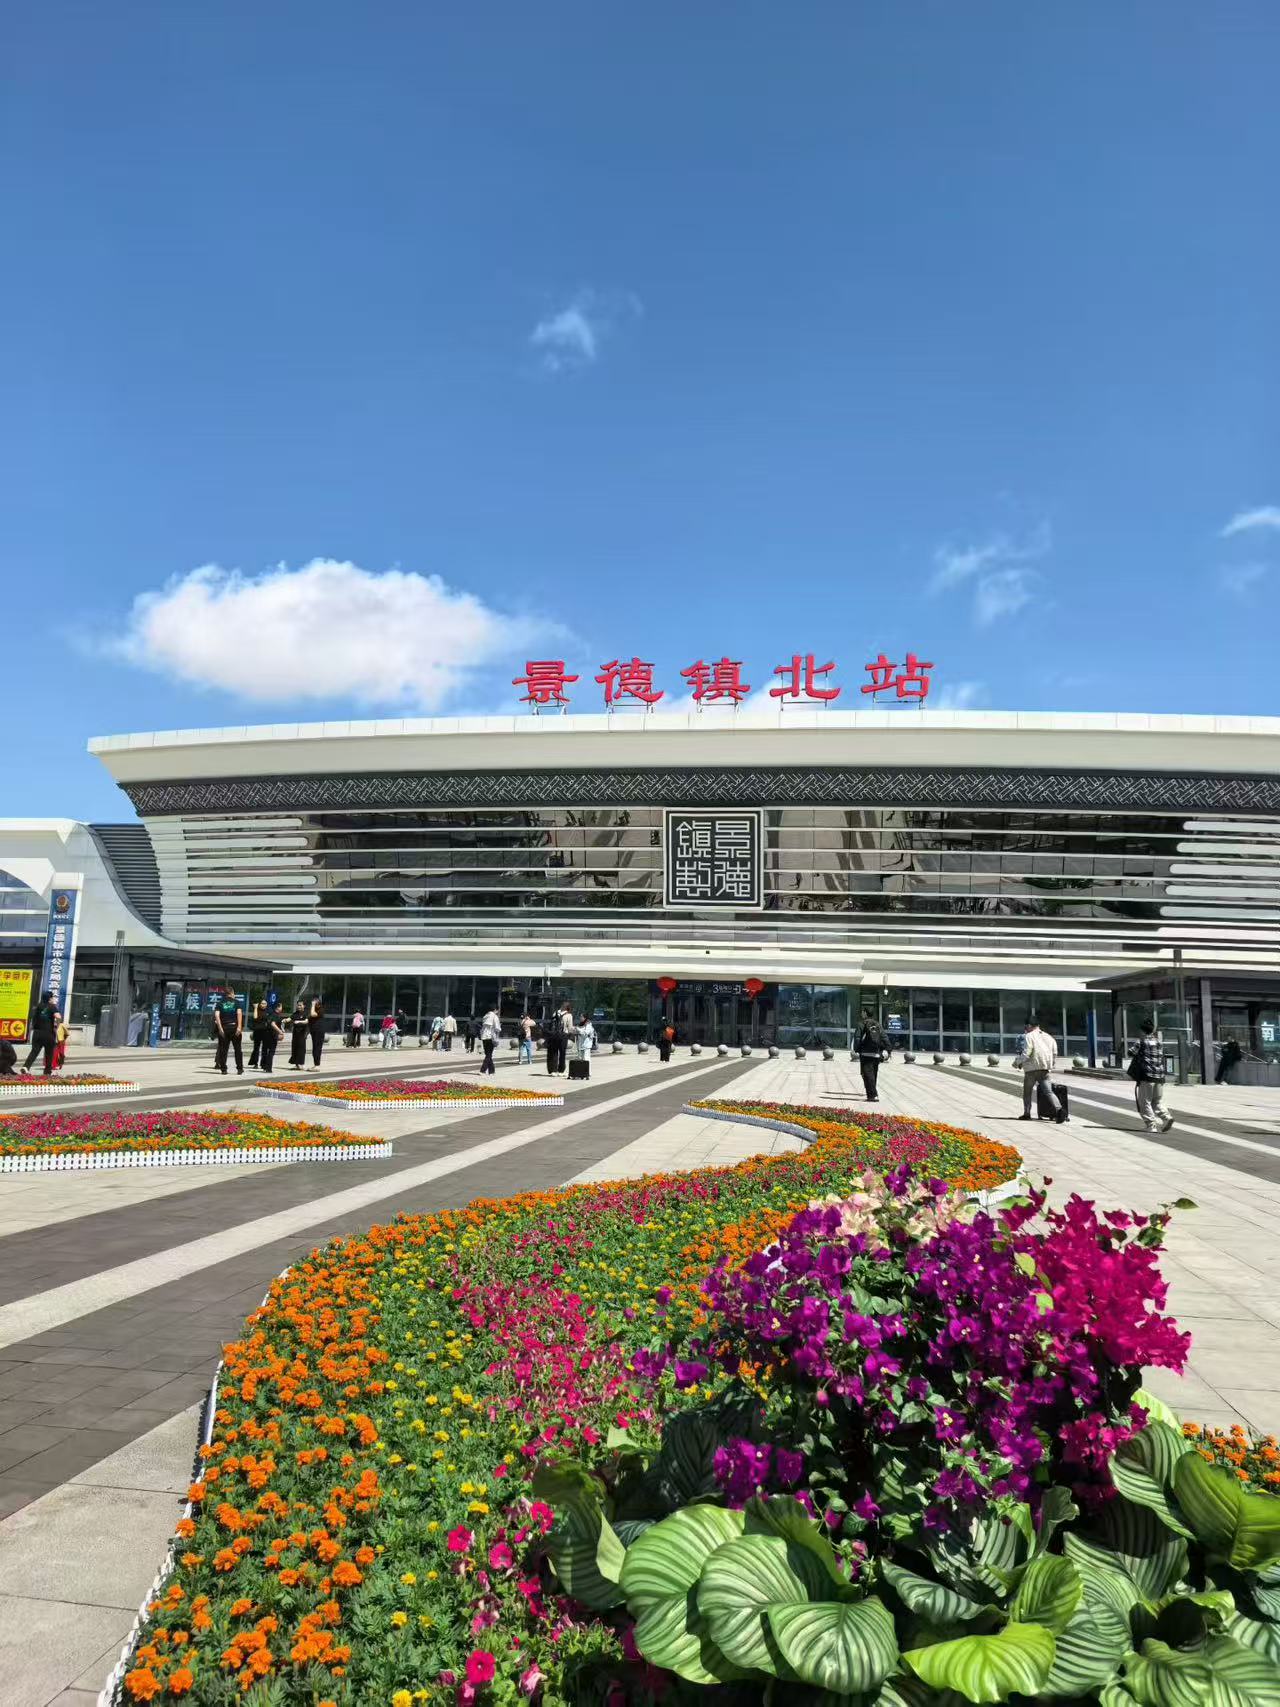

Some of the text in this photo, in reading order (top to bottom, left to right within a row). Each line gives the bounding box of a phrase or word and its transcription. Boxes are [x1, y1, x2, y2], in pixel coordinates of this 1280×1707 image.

[512, 653, 935, 704] 景德镇北站
